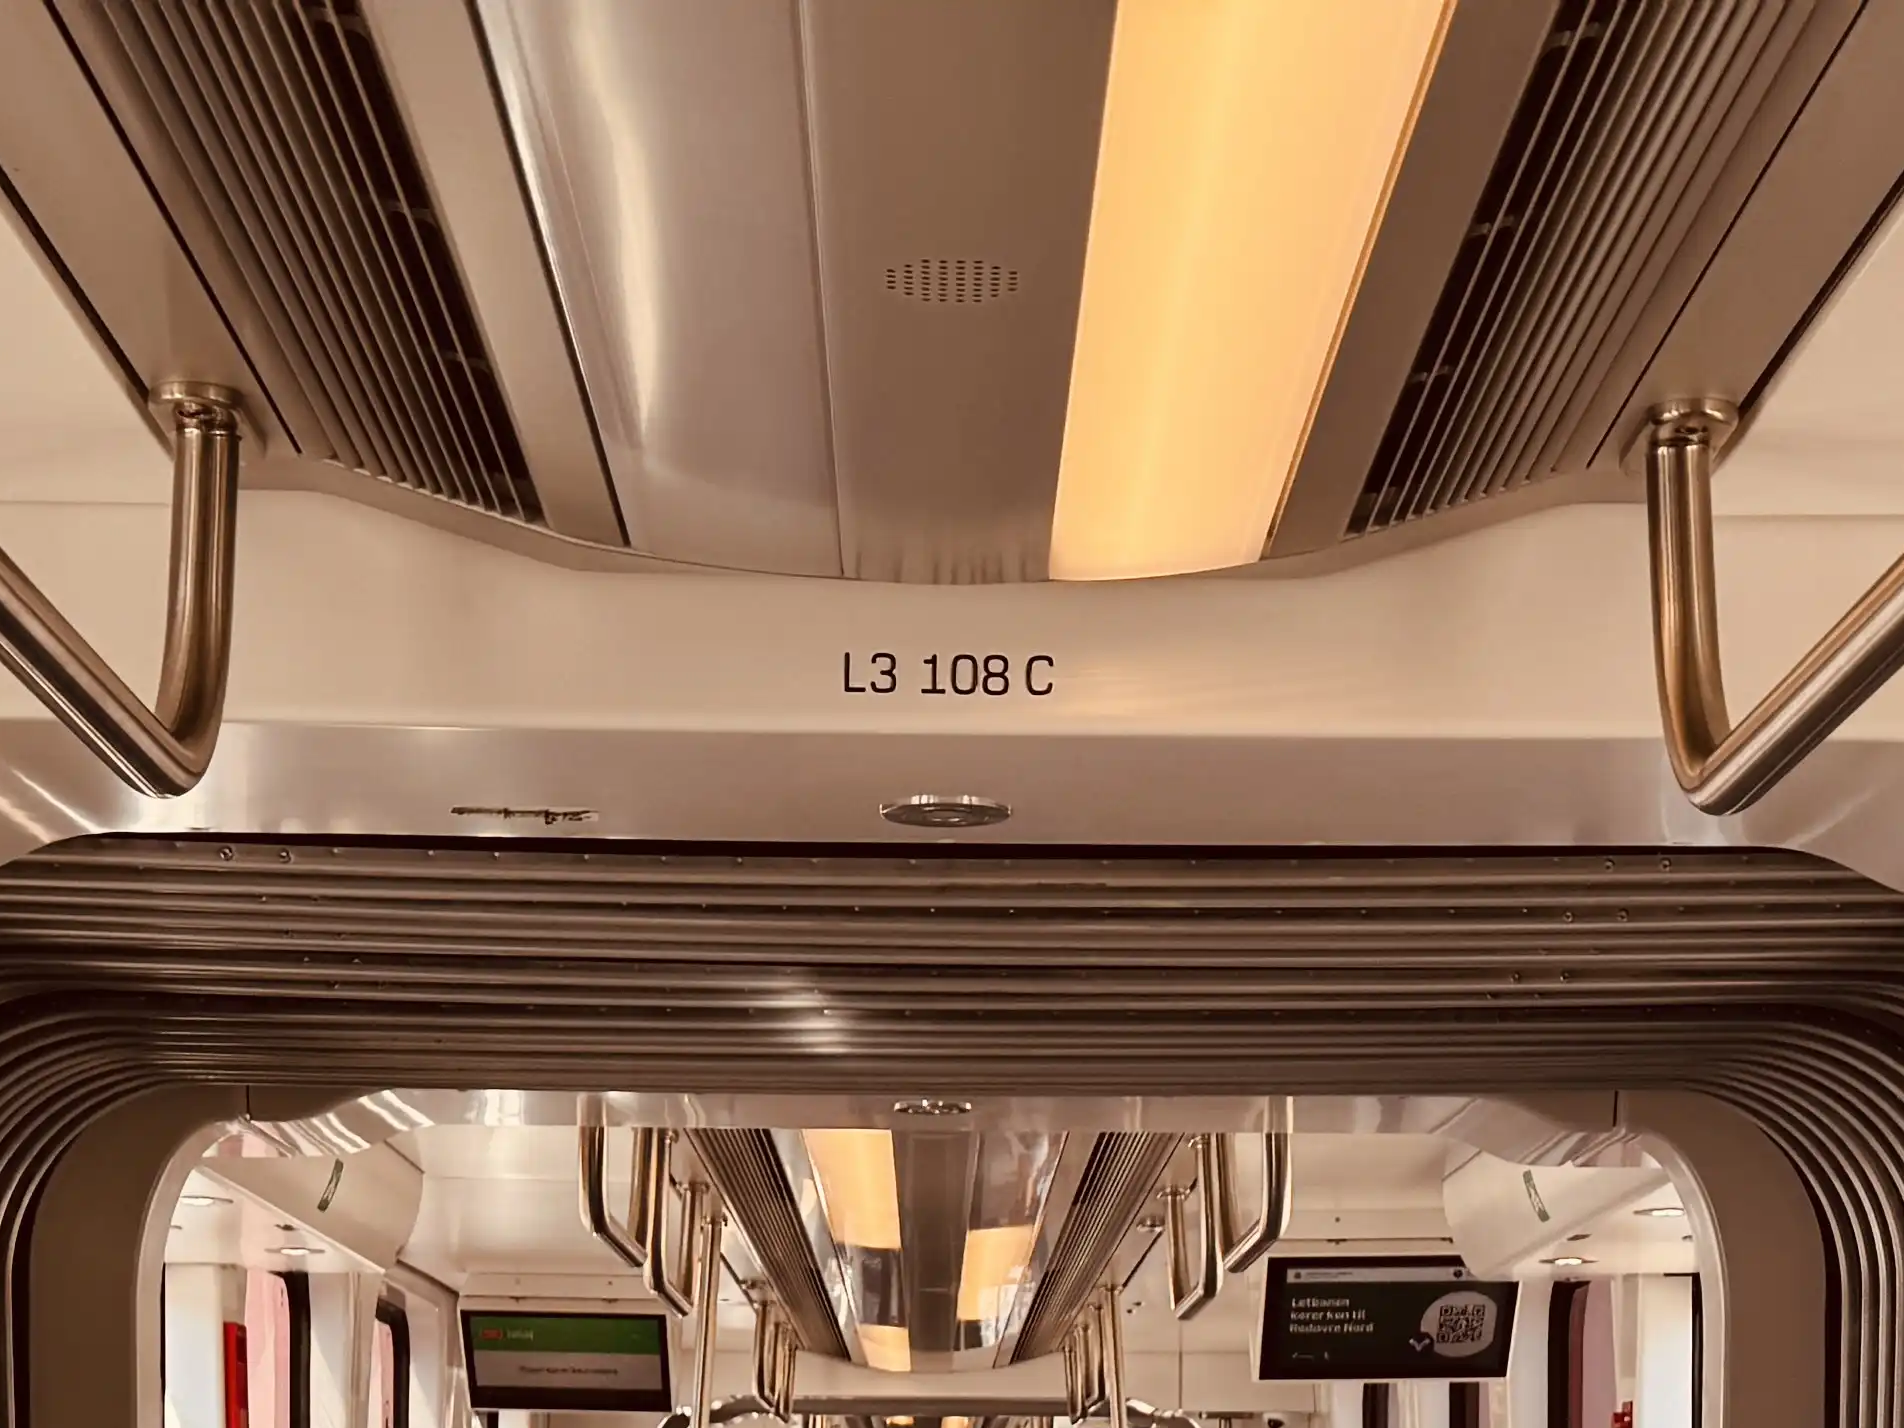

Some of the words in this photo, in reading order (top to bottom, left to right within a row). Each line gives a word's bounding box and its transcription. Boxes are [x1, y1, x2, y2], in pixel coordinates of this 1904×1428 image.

[844, 652, 897, 693] L3
[921, 653, 1010, 696] 108
[1025, 655, 1054, 696] C
